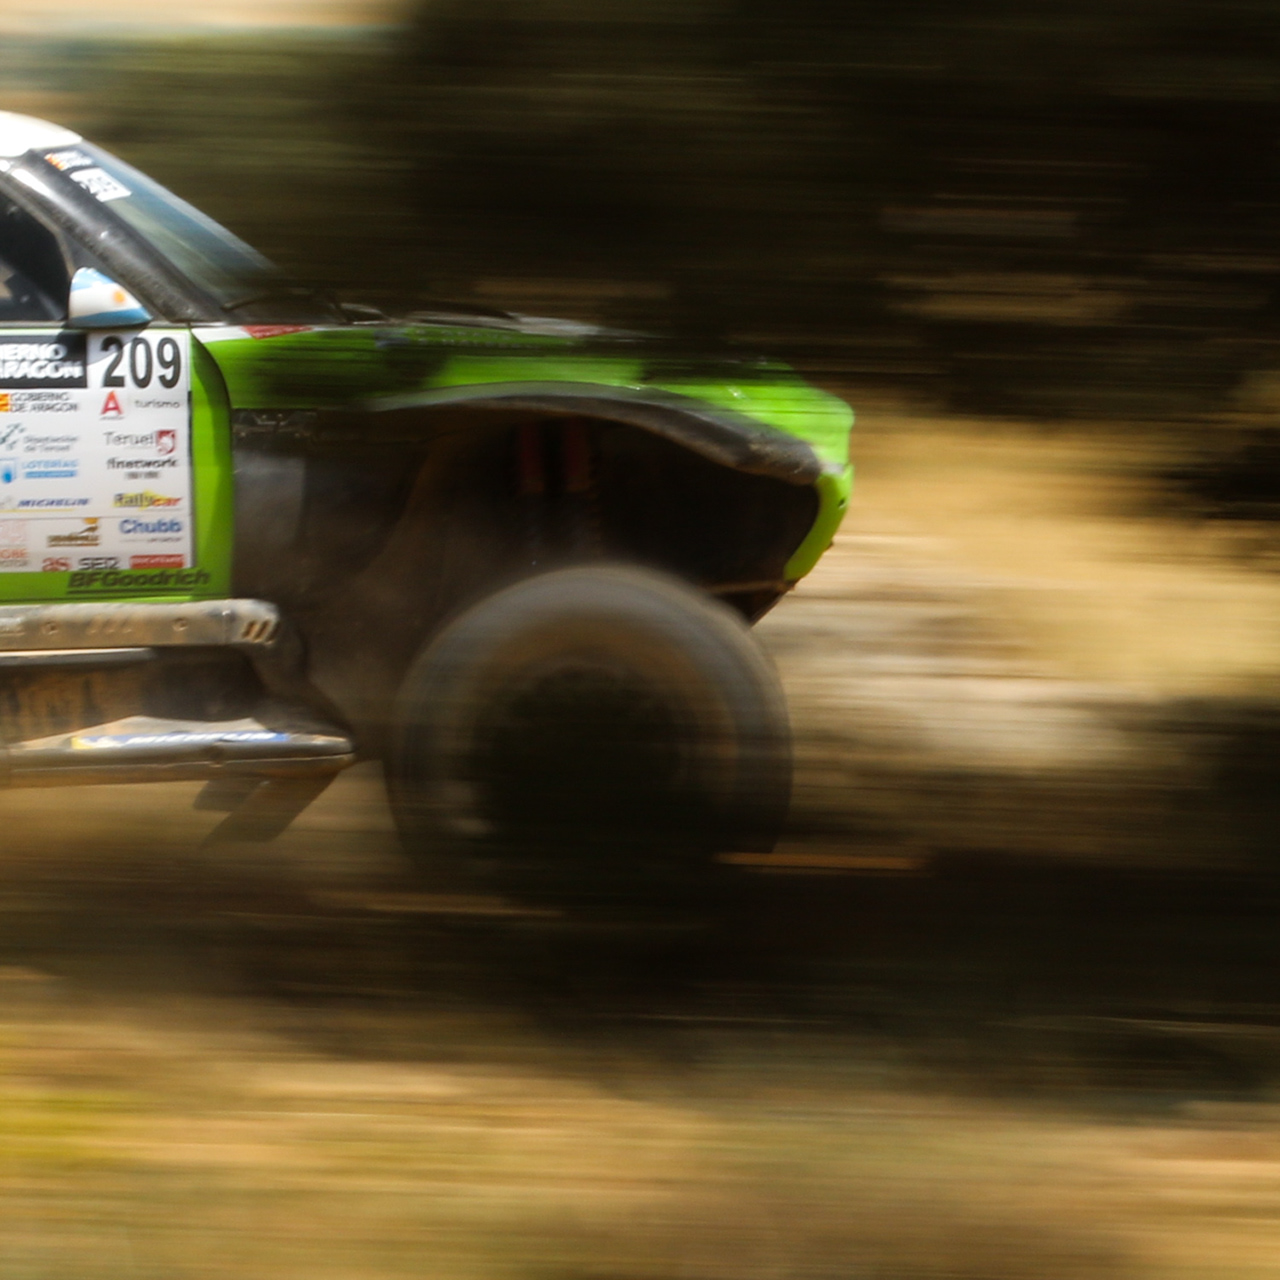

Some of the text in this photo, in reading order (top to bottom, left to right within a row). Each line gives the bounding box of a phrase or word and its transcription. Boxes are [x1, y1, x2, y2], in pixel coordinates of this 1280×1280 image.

[100, 336, 182, 389] 209
[11, 392, 71, 402] GOBIERNO
[11, 403, 28, 413] DE
[134, 399, 181, 409] turismo
[103, 431, 154, 446] Teruel
[17, 498, 91, 508] MICHELIN
[120, 518, 183, 535] Chubb
[67, 570, 211, 589] BFGoodrich
